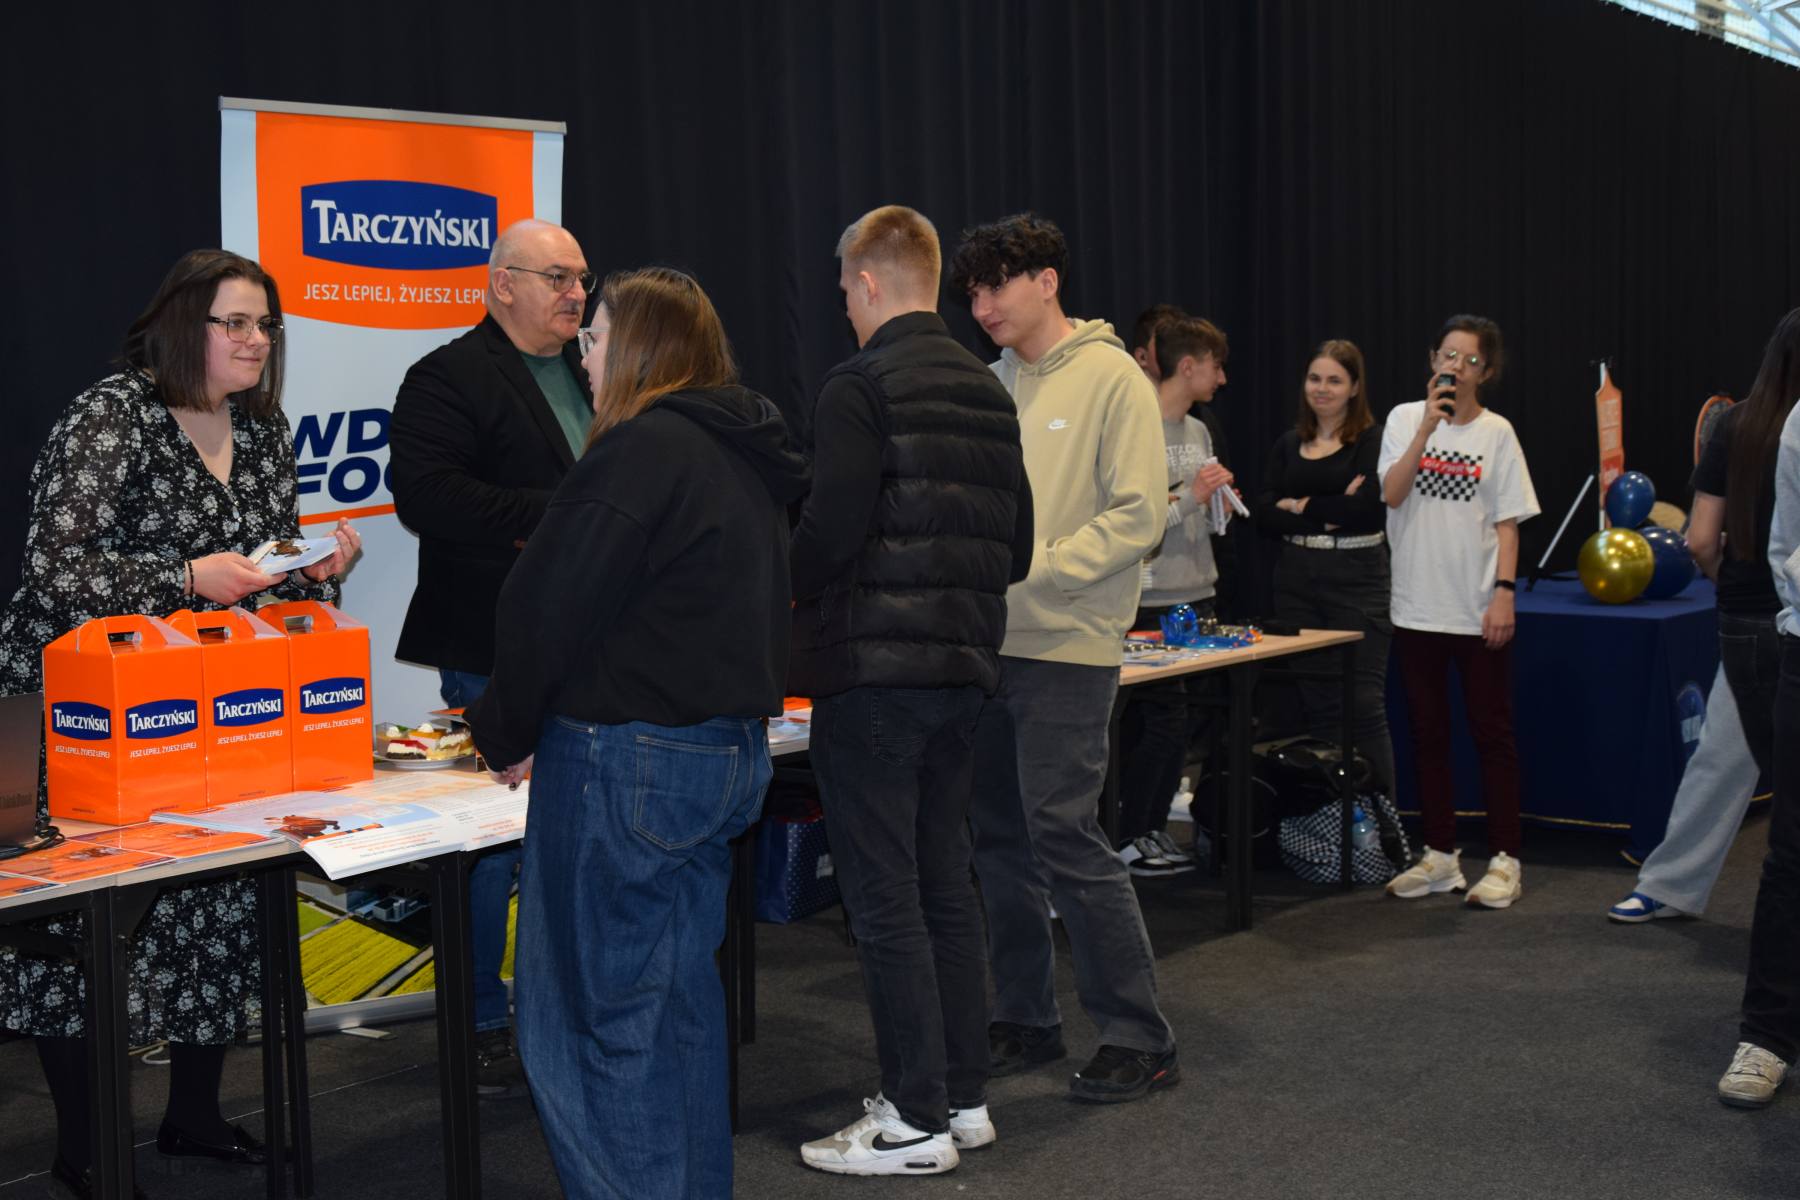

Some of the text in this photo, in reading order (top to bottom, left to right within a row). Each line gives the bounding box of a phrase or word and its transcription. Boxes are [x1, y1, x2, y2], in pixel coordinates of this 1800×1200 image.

[310, 199, 490, 249] TARCZYŃSKI
[303, 283, 486, 304] JESZ LEPIEJ, ŻYJESZ LEPI
[302, 686, 363, 709] TARCZYŃSKI
[54, 708, 109, 733] TARCZYŃSKI
[128, 709, 196, 733] TARCZYŃSKI
[216, 698, 282, 721] TARCZYŃSKI
